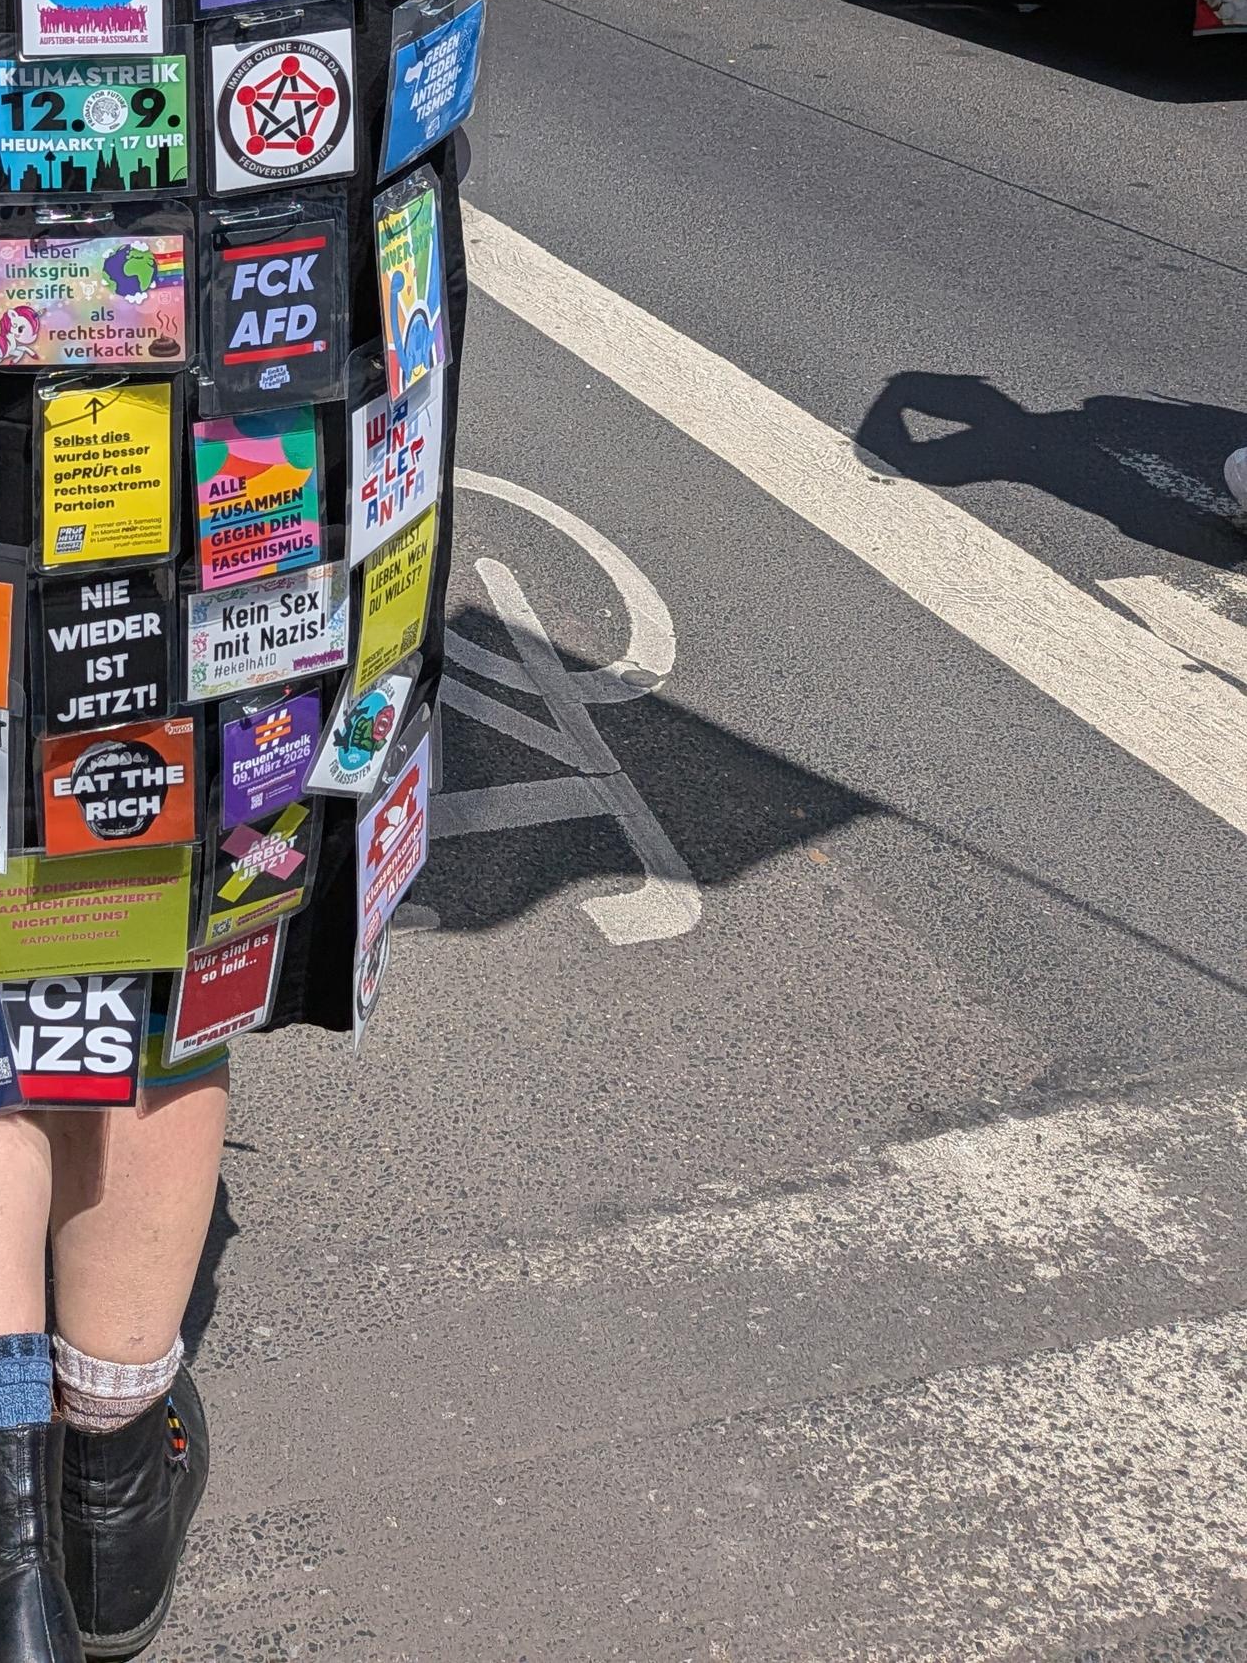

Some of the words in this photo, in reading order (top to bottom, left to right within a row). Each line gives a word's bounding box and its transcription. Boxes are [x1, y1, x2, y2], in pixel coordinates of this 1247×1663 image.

[424, 32, 459, 67] GEGEN
[0, 64, 180, 87] KLIMASTREIK
[425, 50, 458, 83] JEDEN
[411, 65, 462, 110] ANTISEMI-
[416, 86, 456, 122] TISMUS!
[1, 138, 105, 151] HEUMARKT
[120, 136, 137, 149] 17
[146, 134, 184, 148] UHR
[239, 156, 299, 176] FEDIVERSUM
[302, 144, 333, 171] ANTIFA
[25, 246, 79, 259] Lieber
[6, 264, 89, 281] linksgrün
[232, 254, 319, 300] FCK
[6, 284, 74, 300] versifft
[91, 306, 114, 321] als
[229, 304, 317, 348] AFD
[49, 326, 157, 341] rechtsbraun
[64, 343, 143, 358] verkackt
[54, 436, 98, 447] Selbst
[101, 432, 130, 443] dies
[54, 450, 99, 463] wurde
[103, 445, 150, 459] besser
[54, 463, 118, 484] gePRÜFt
[121, 464, 141, 475] als
[54, 478, 160, 496] rechtsextreme
[209, 476, 246, 498] ALLE
[55, 499, 114, 513] Parteien
[210, 487, 303, 523] ZUSAMMEN
[211, 521, 264, 546] GEGEN
[270, 513, 301, 532] DEN
[212, 534, 313, 572] FASCHISMUS
[372, 551, 385, 570] DU
[389, 525, 421, 557] WILLST
[81, 580, 130, 611] NIE
[370, 596, 381, 616] DU
[386, 565, 422, 604] WILLST?
[222, 602, 268, 631] Kein
[280, 591, 319, 617] Sex
[48, 613, 161, 652] WIEDER
[214, 631, 249, 661] mit
[261, 613, 325, 651] Nazis!
[86, 653, 128, 683] IST
[214, 653, 276, 679] #ekelhAfD
[57, 683, 157, 722] JETZT!
[171, 724, 193, 734] JUSOS
[233, 771, 250, 785] 09.
[254, 760, 281, 778] März
[283, 745, 310, 765] 2026
[54, 774, 115, 797] EAT
[121, 766, 184, 788] THE
[85, 796, 160, 821] RICH
[231, 836, 297, 872] VERBOT
[248, 832, 281, 853] AFD
[239, 851, 288, 882] JETZT
[67, 892, 163, 907] FINANZIERT?
[12, 918, 59, 929] NICHT
[62, 914, 89, 924] MIT
[92, 911, 128, 922] UNS!
[193, 954, 216, 972] Wir
[222, 939, 250, 961] sind
[254, 934, 269, 947] es
[201, 971, 216, 984] so
[222, 957, 257, 977] leid...
